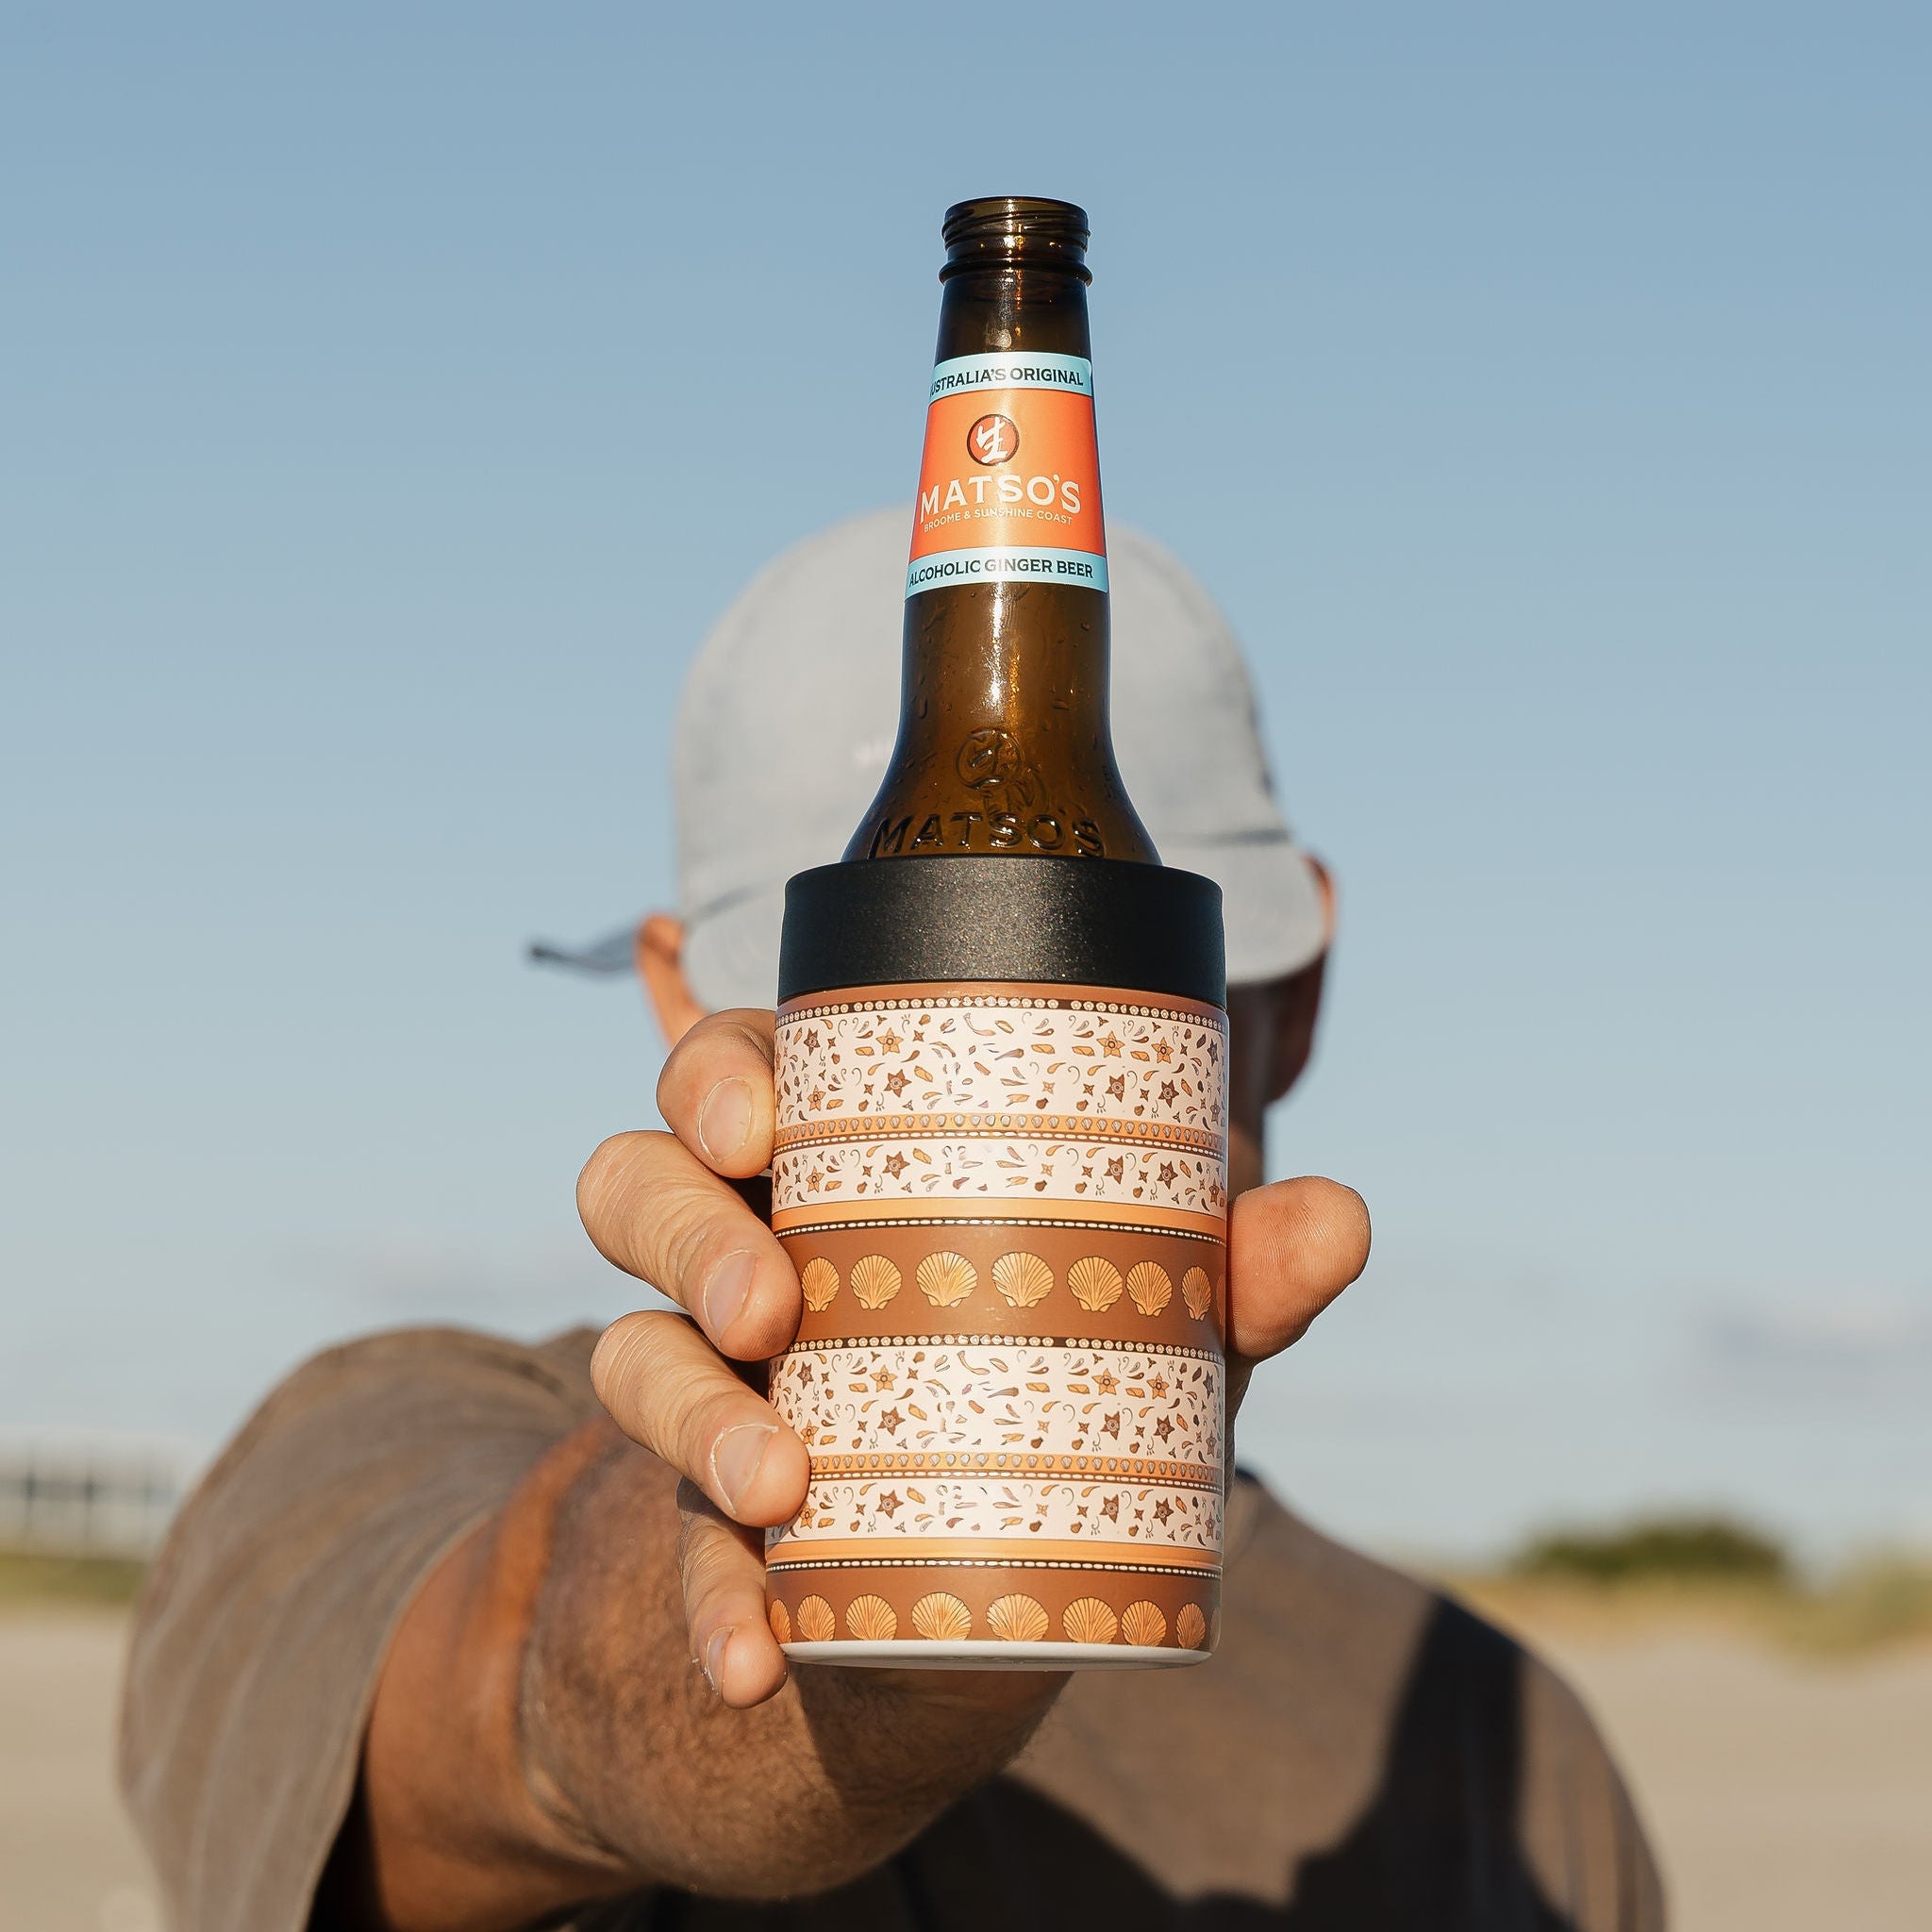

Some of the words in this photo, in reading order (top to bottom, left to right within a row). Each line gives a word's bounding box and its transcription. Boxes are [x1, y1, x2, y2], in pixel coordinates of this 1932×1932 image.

[1009, 367, 1084, 387] ORIGINAL
[919, 474, 1082, 525] MATSO'S
[924, 511, 961, 533] BROOME
[974, 507, 1034, 518] SUNSHINE
[1037, 510, 1073, 525] COAST
[908, 559, 981, 588] ALCOHOLIC
[984, 558, 1053, 573] GINGER
[1057, 559, 1094, 578] BEER
